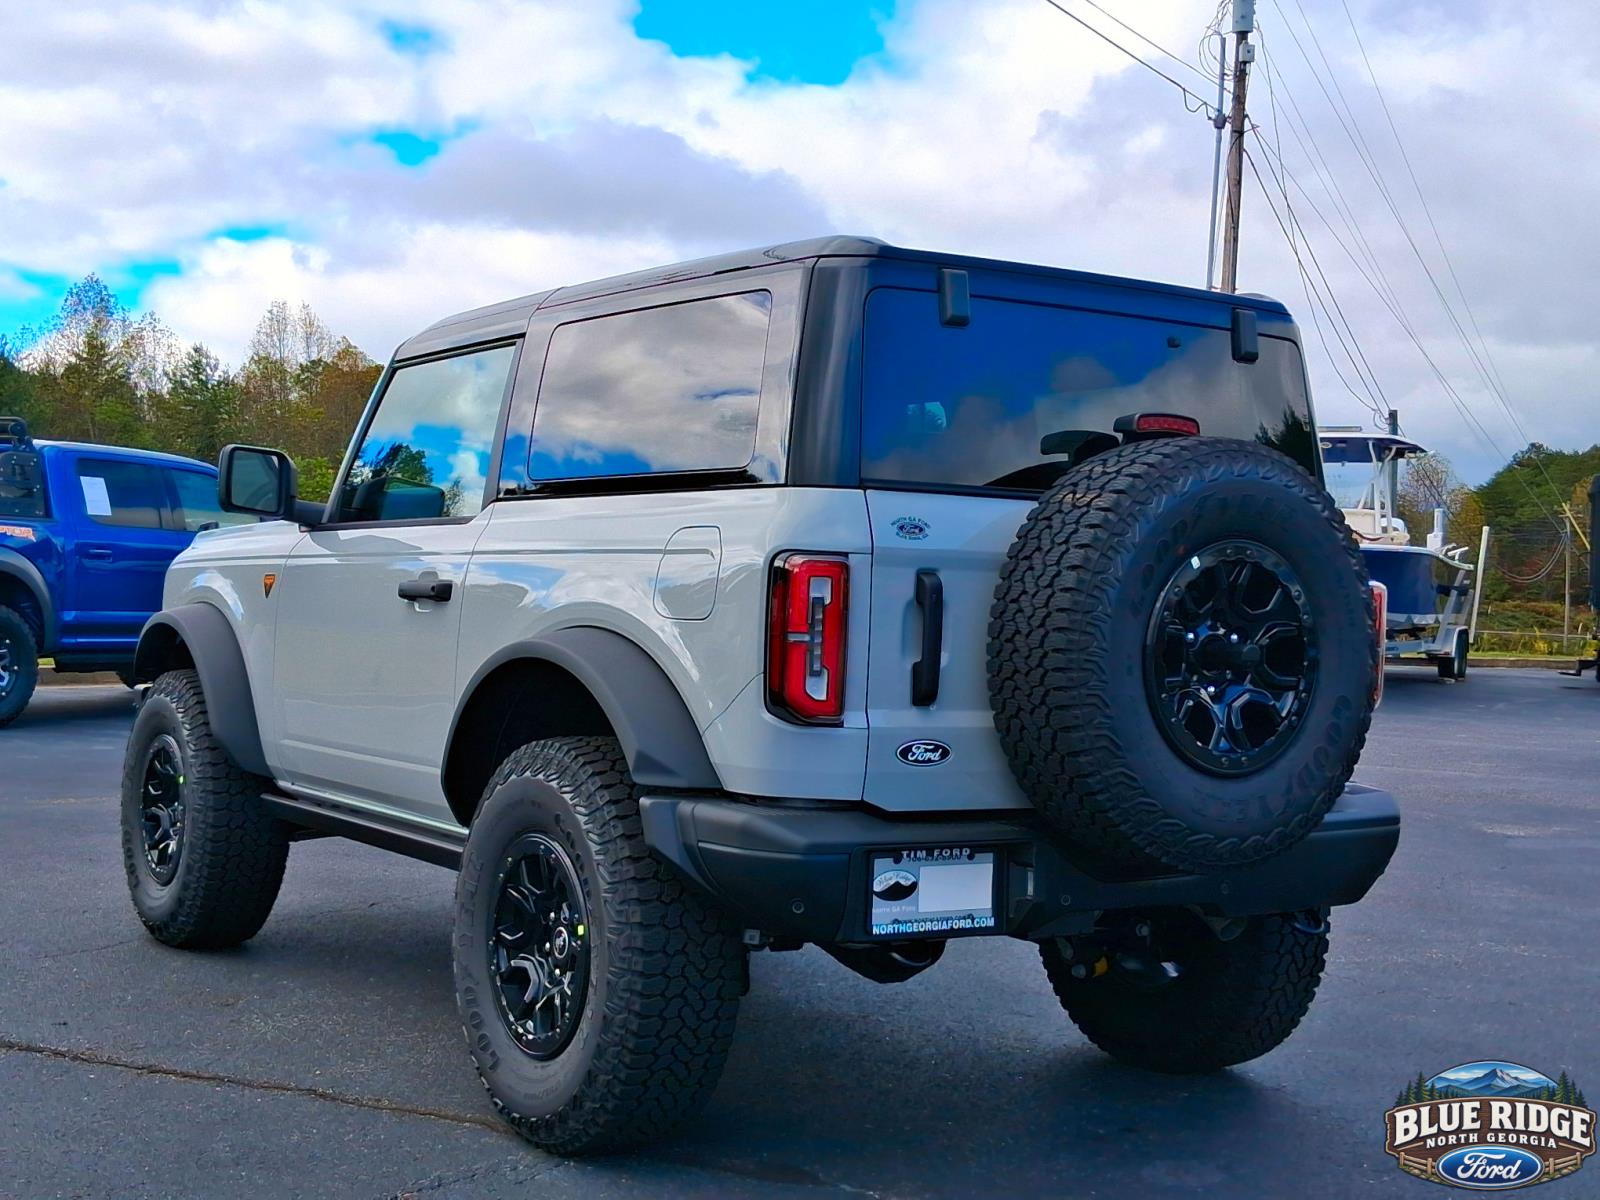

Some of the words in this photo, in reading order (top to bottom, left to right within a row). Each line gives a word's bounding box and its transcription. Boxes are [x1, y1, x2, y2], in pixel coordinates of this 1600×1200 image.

[907, 744, 943, 761] Ford
[901, 850, 926, 859] TIM
[933, 847, 971, 857] FORD
[872, 917, 995, 935] NORTHGEORGIAFORD.COM
